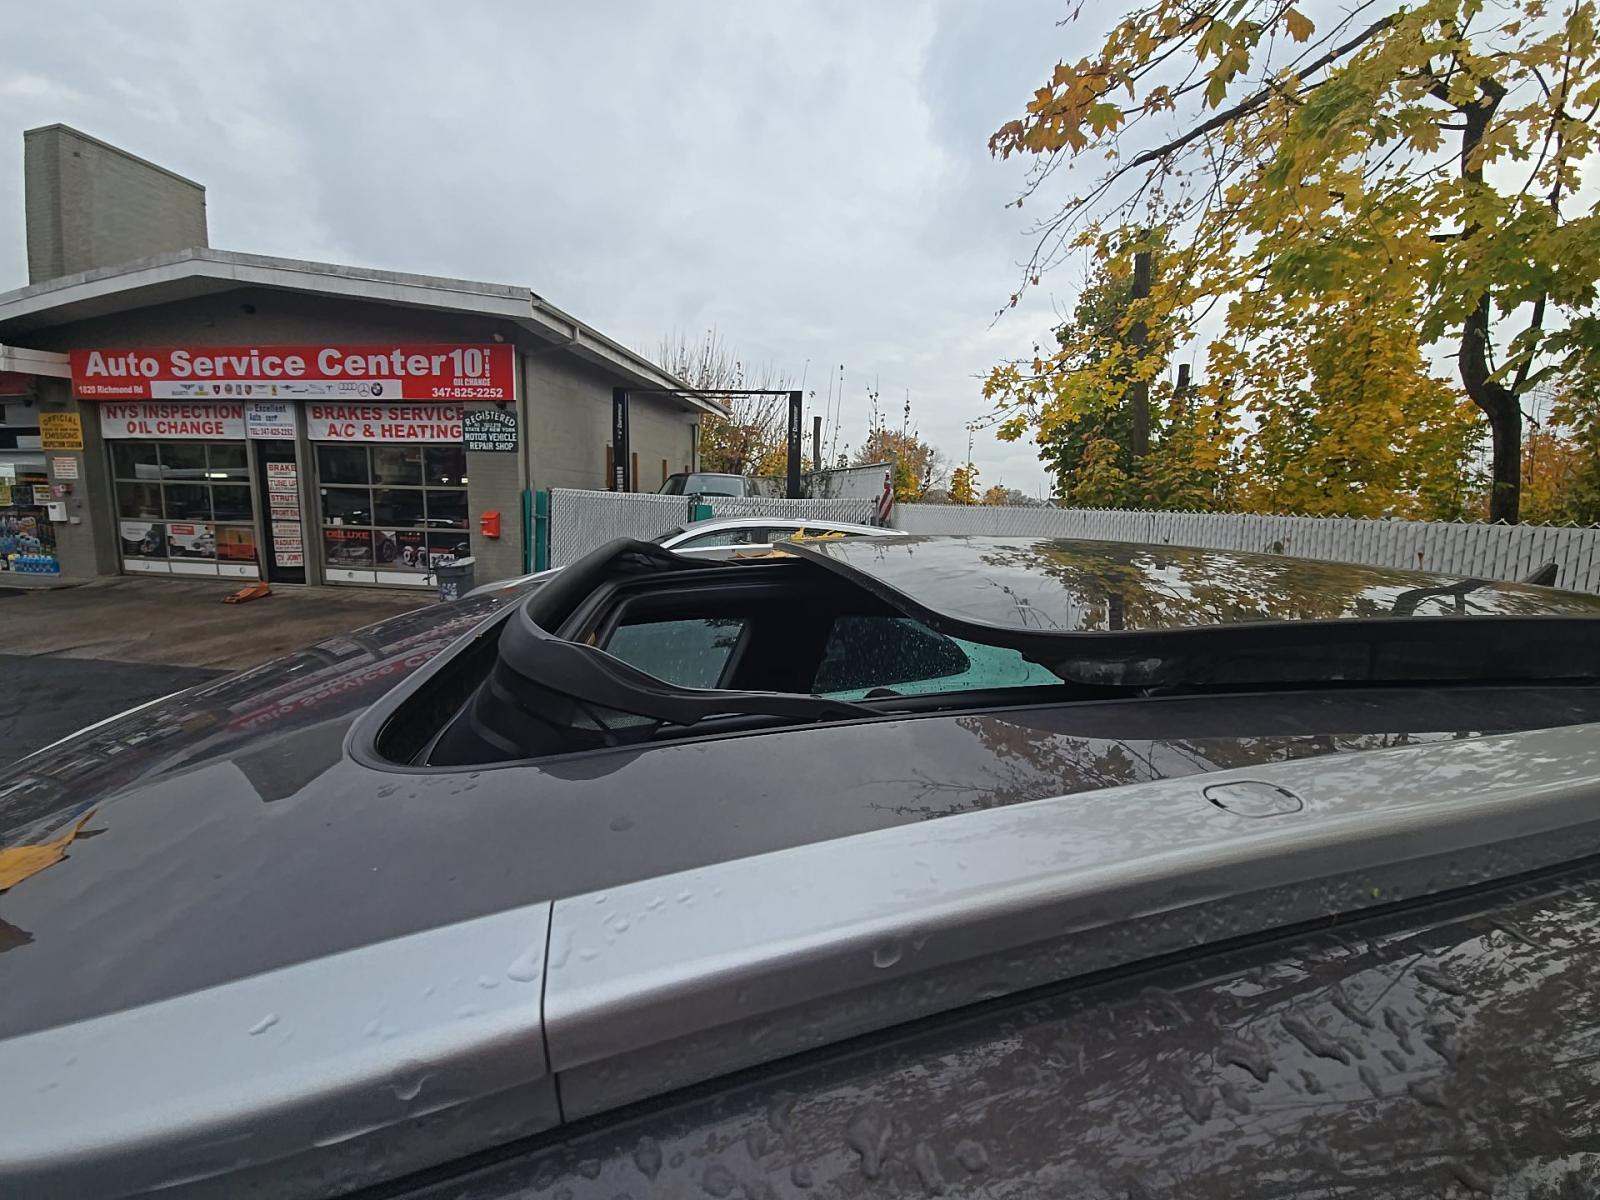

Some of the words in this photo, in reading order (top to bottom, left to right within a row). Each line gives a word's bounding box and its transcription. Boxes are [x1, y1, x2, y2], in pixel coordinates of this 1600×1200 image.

[85, 351, 160, 378] Auto
[170, 349, 306, 378] Service
[317, 348, 447, 377] Center
[449, 348, 483, 378] 10
[453, 378, 463, 386] OIL
[464, 378, 491, 386] CHANGE
[97, 385, 133, 394] Richmond
[133, 385, 144, 394] Rd
[431, 387, 504, 399] 347-825-2252
[105, 404, 141, 420] NYS
[142, 404, 243, 420] INSPECTION
[311, 405, 382, 420] BRAKES
[388, 406, 465, 421] SERVICE
[464, 410, 516, 427] REGISTERED
[42, 414, 79, 426] OFFICIAL
[126, 421, 153, 435] OIL
[156, 421, 225, 435] CHANGE
[327, 423, 356, 438] A/C
[362, 424, 375, 438] &
[381, 424, 462, 439] HEATING
[464, 433, 487, 441] MOTOR
[488, 433, 517, 441] VEHICLE
[469, 442, 494, 450] REPAIR
[495, 442, 514, 450] SHOP
